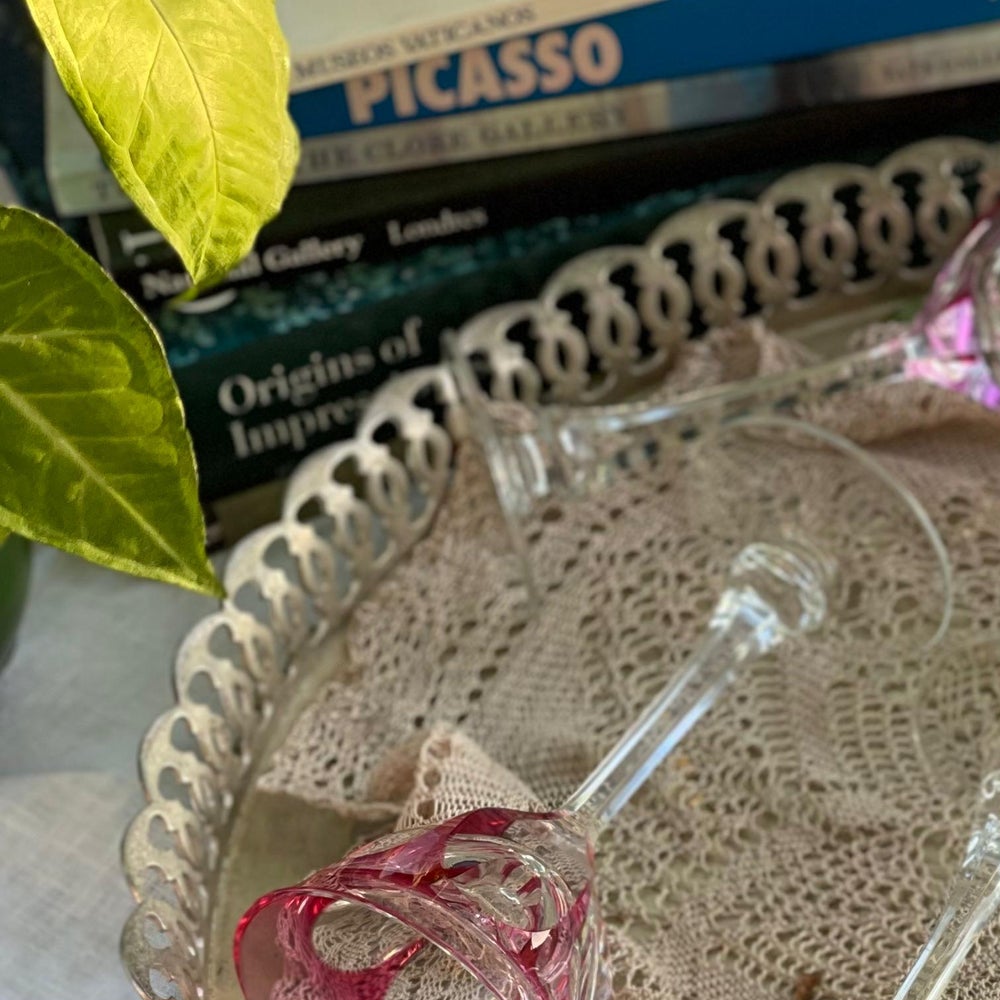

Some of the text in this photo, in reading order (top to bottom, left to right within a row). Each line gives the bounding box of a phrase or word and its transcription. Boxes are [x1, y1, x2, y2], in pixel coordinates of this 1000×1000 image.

[293, 6, 534, 77] MUSEOS VATICANOS
[344, 22, 623, 126] PICASSO
[262, 232, 365, 273] Gallery
[218, 315, 423, 416] Origins of
